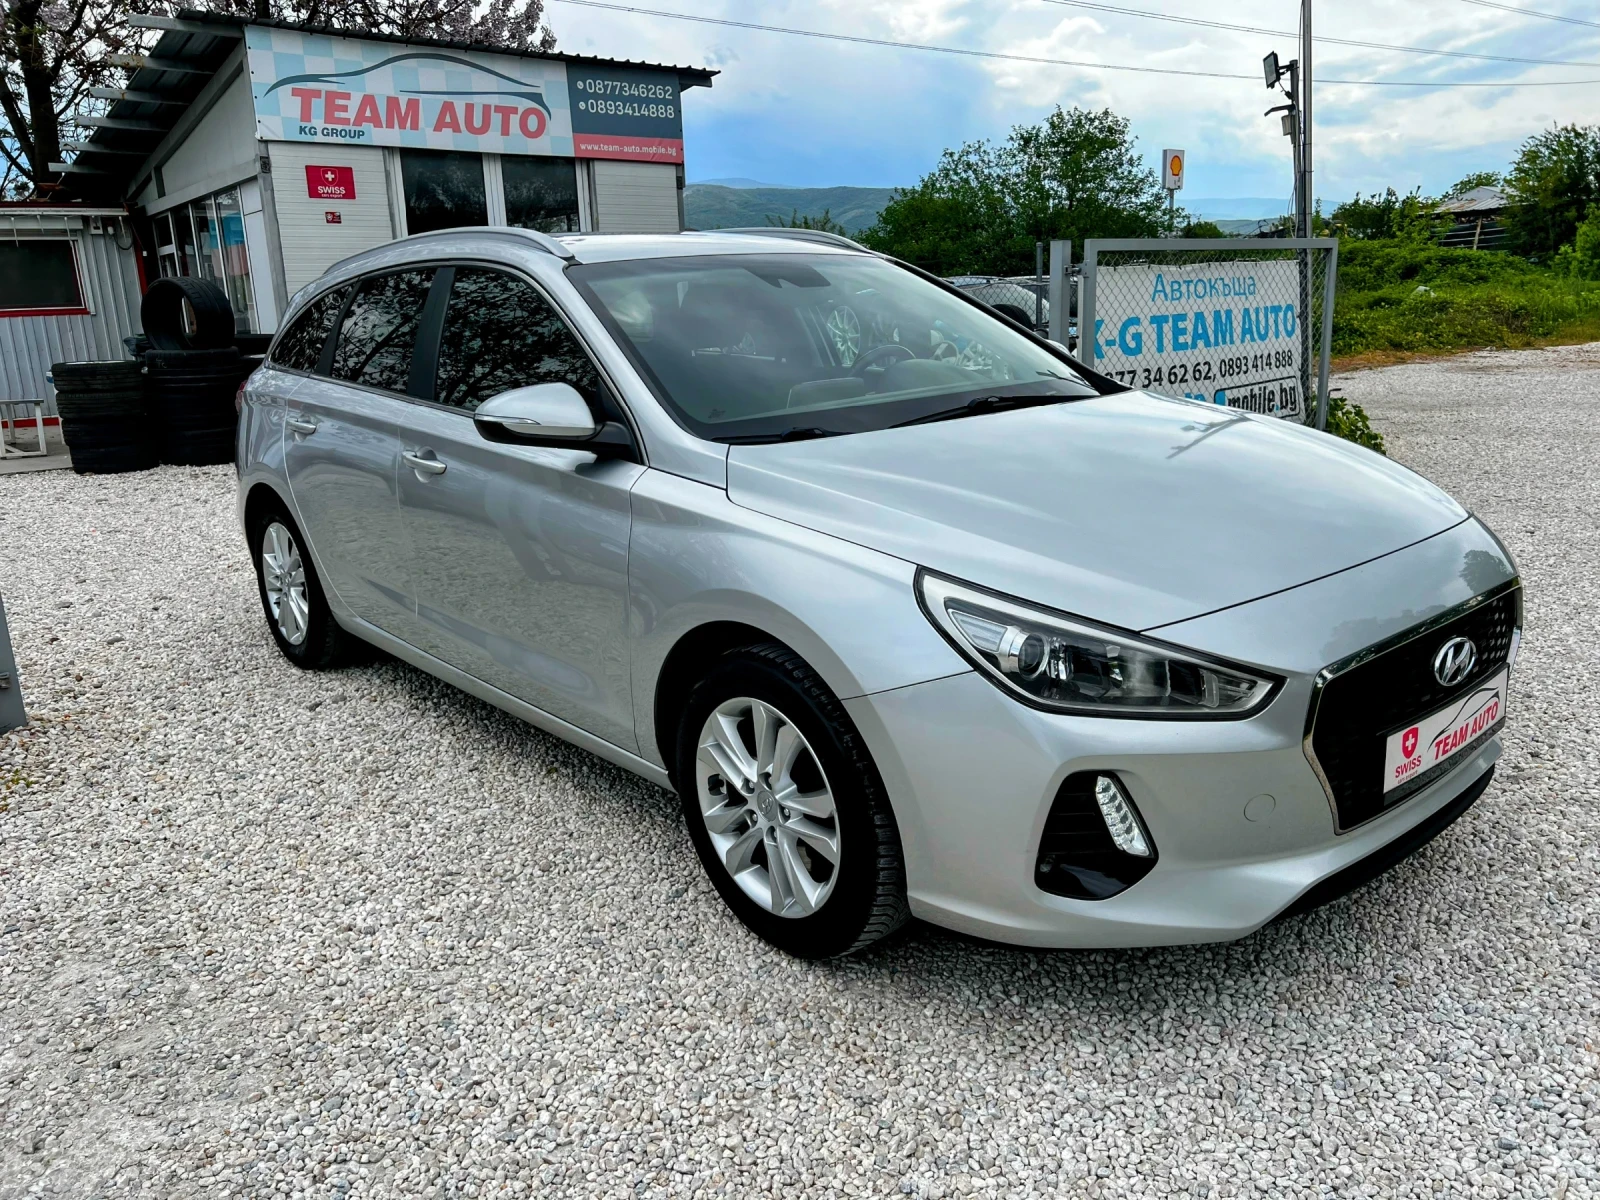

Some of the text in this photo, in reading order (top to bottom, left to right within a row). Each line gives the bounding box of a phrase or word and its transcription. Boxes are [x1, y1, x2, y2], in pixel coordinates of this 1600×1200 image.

[586, 79, 673, 99] 0877346262
[291, 87, 547, 139] TEAM AUTO
[588, 99, 675, 118] 0893414888
[299, 125, 365, 140] KG GROUP
[579, 143, 677, 156] www.team-auto.mobile.bg
[317, 185, 346, 195] SWISS
[1151, 273, 1256, 302] Автокъща
[1149, 308, 1235, 354] TEAM
[1240, 303, 1297, 344] AUTO
[1142, 366, 1164, 389] 34
[1167, 363, 1188, 385] 62
[1192, 361, 1217, 383] 62,
[1219, 355, 1249, 378] 0893
[1252, 352, 1272, 373] 414
[1274, 349, 1293, 369] 888
[1433, 700, 1499, 761] TEAM AUTO
[1394, 754, 1422, 779] SWISS
